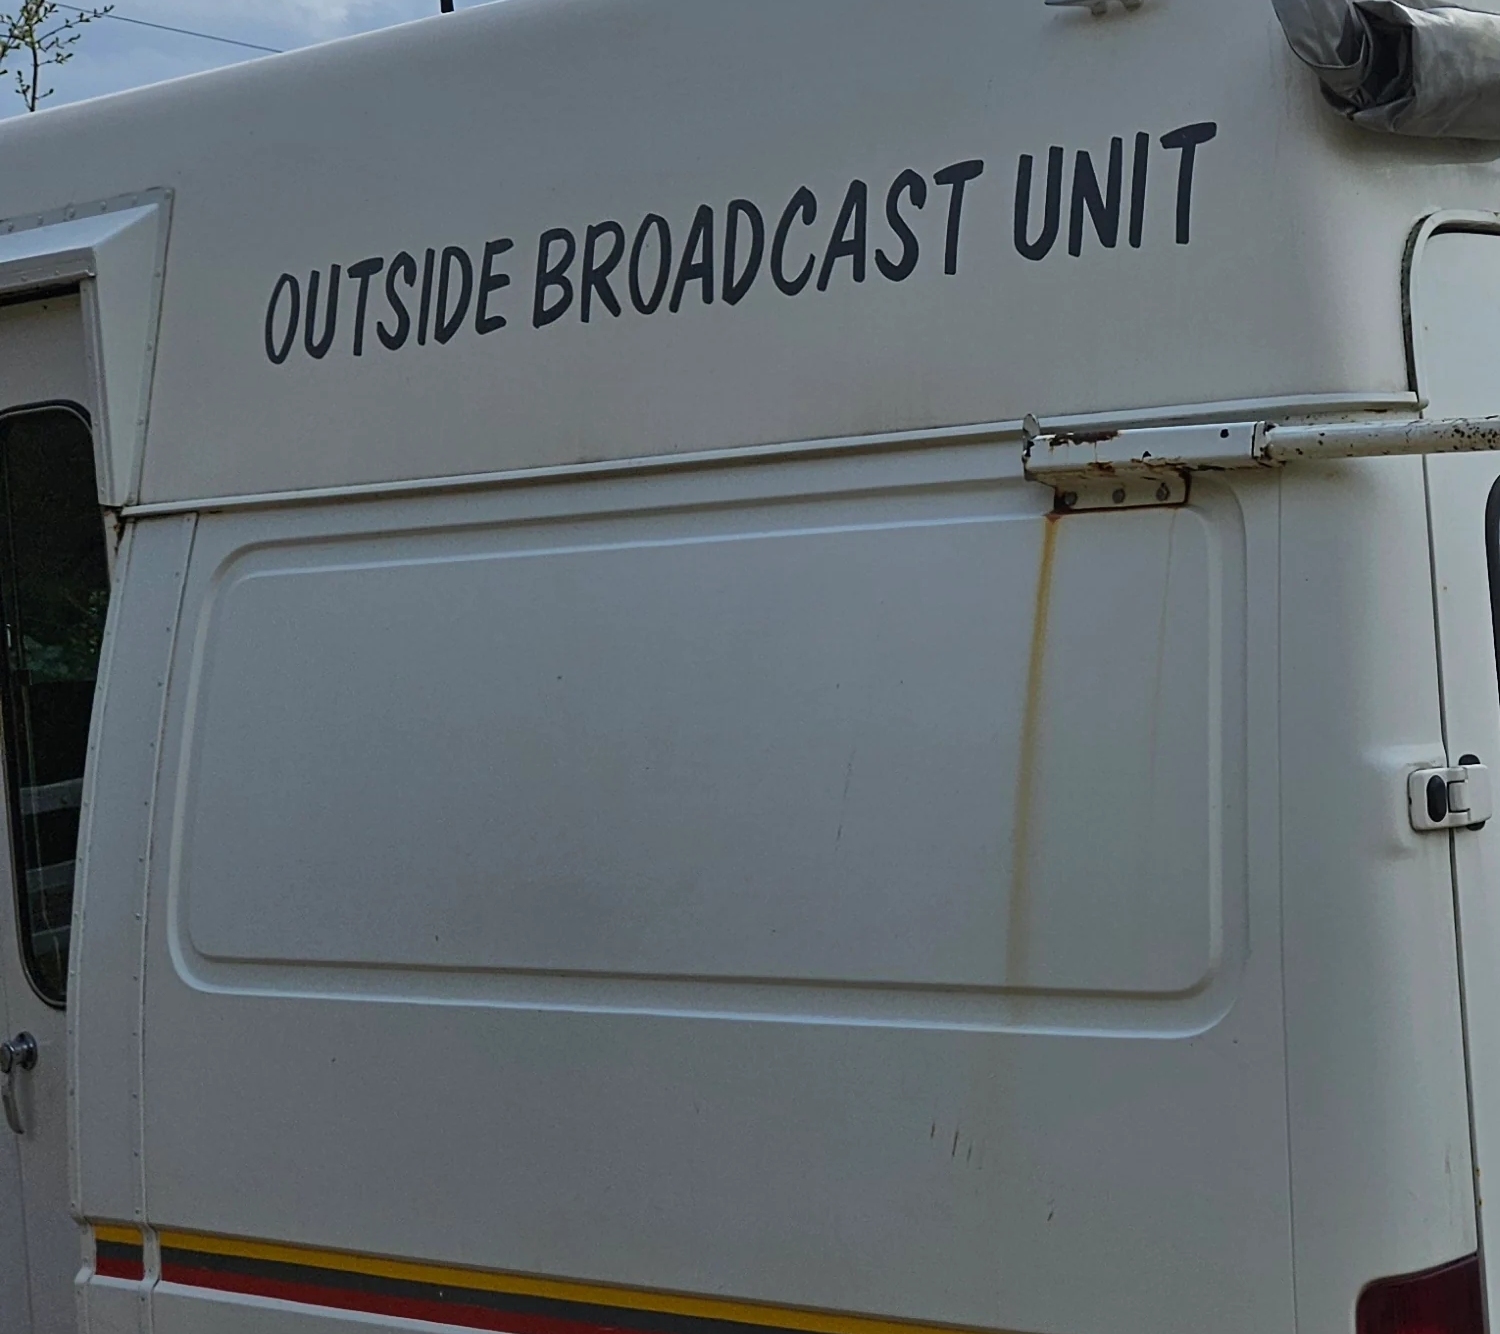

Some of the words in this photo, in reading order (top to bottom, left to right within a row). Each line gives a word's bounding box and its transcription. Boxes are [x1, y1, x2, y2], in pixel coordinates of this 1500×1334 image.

[264, 238, 514, 365] OUTSIDE
[532, 159, 985, 330] BROADCAST
[1013, 121, 1218, 262] UNIT
